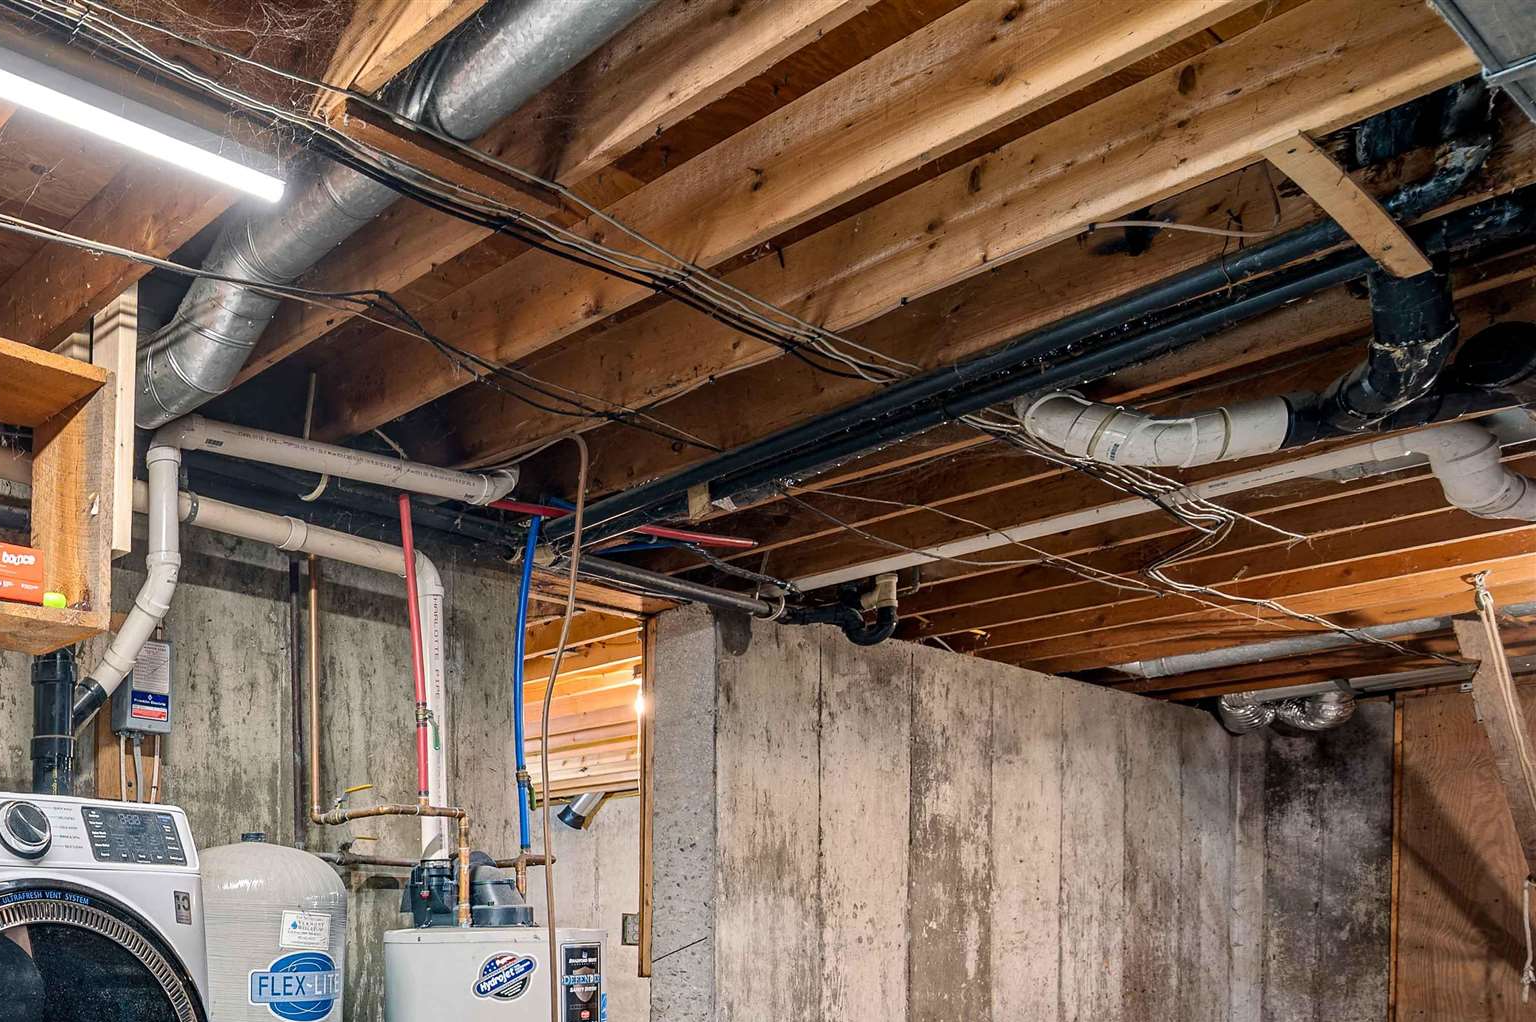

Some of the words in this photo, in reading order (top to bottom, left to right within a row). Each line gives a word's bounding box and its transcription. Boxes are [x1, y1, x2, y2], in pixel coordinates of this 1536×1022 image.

[2, 890, 43, 904] ULTRAFRESH
[46, 890, 62, 899] VENT
[65, 893, 89, 906] SYSTEM
[258, 973, 341, 997] FLEX-LITE
